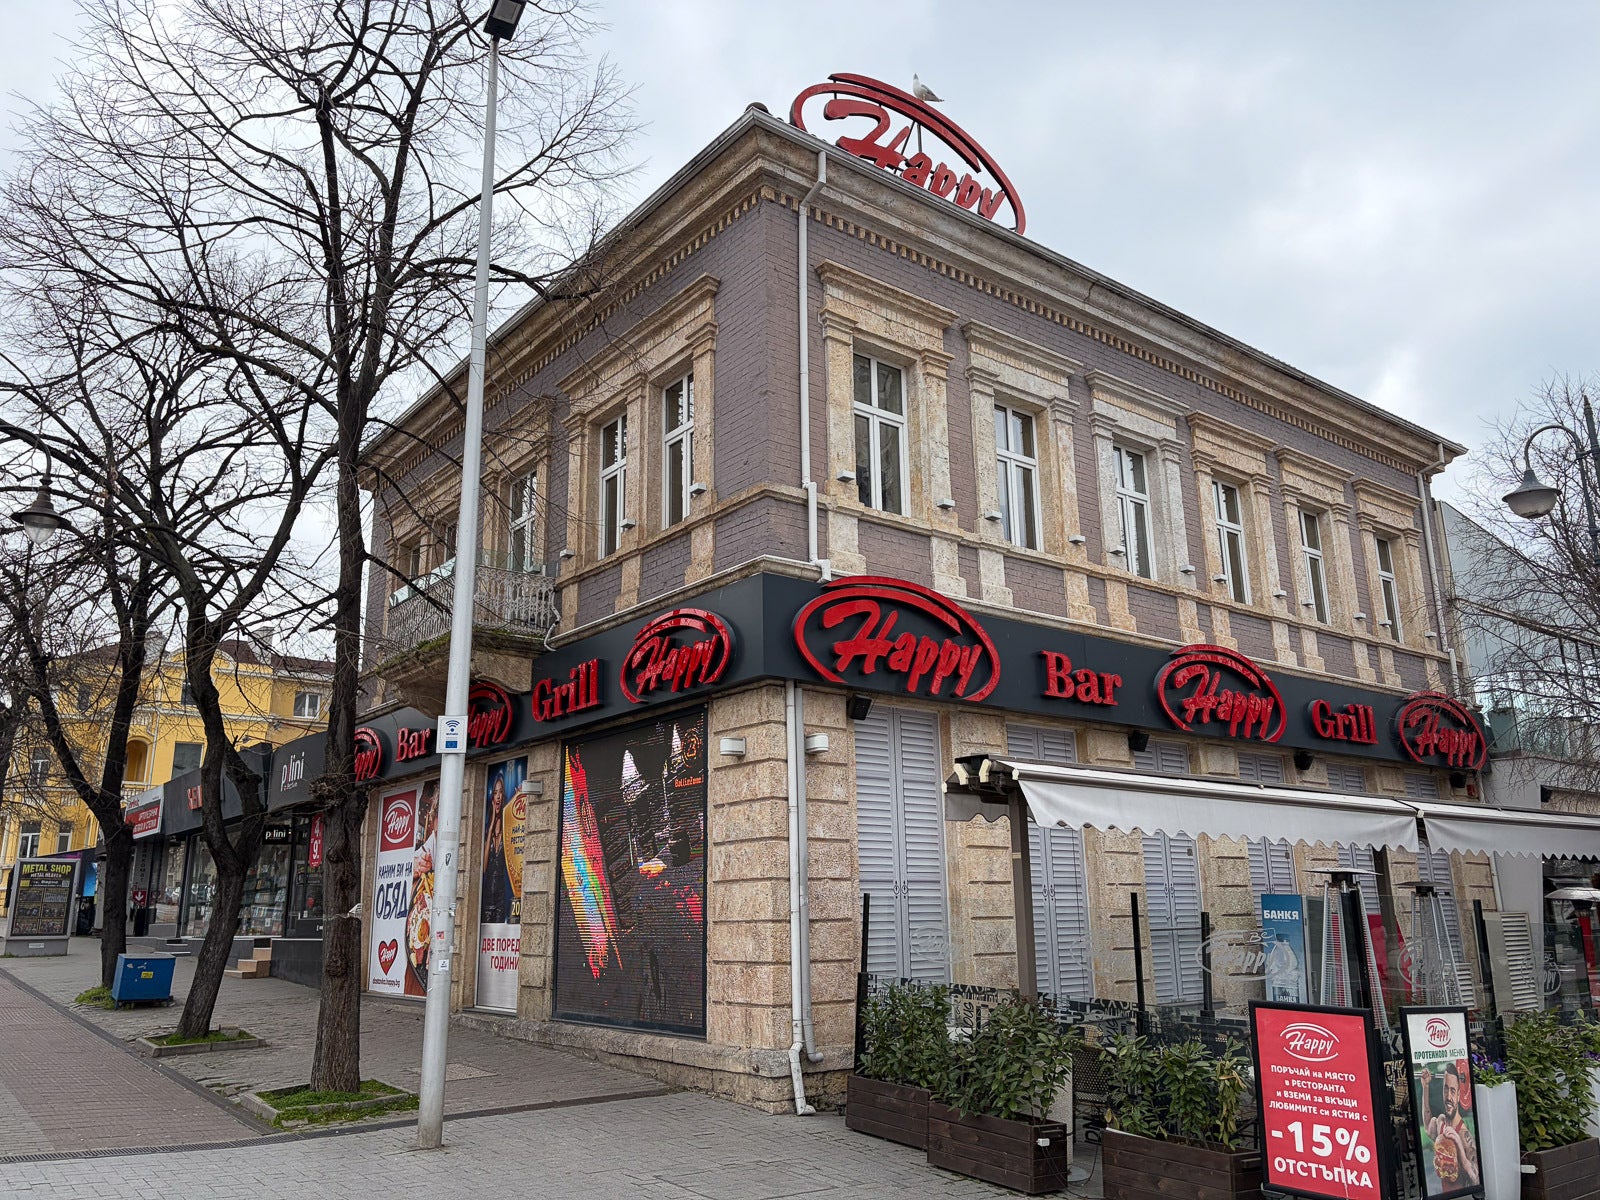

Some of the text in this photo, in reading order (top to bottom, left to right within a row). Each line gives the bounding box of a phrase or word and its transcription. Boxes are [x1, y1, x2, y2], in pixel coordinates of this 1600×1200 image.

[822, 600, 1478, 767] Happy Bar Happy Grill Happy
[396, 726, 431, 762] Bar
[531, 658, 600, 723] Grill
[631, 634, 720, 696] Happy
[386, 810, 411, 835] Happy
[22, 864, 72, 876] METAL SHOP
[404, 861, 413, 877] НА
[376, 880, 409, 920] ОБЯД
[1263, 909, 1299, 920] БАНКЯ
[481, 938, 495, 953] ДВЕ
[1427, 1025, 1449, 1042] Happy
[1286, 1031, 1334, 1055] Happy
[1414, 1048, 1466, 1060] ПРОТЕИНОВО МЕНЮ
[1270, 1065, 1311, 1077] ПОРЪЧАЙ
[1324, 1071, 1356, 1082] МЯСТО
[1291, 1079, 1346, 1094] РЕСТОРАНТА
[1283, 1090, 1311, 1101] ВЗЕМИ
[1324, 1096, 1358, 1108] ВКЪЩИ
[1269, 1100, 1318, 1115] ЛЮБИМИТЕ
[1319, 1109, 1330, 1117] си
[1331, 1109, 1360, 1121] ЯСТИЯ
[1274, 1156, 1374, 1189] ОТСТЪПКА
